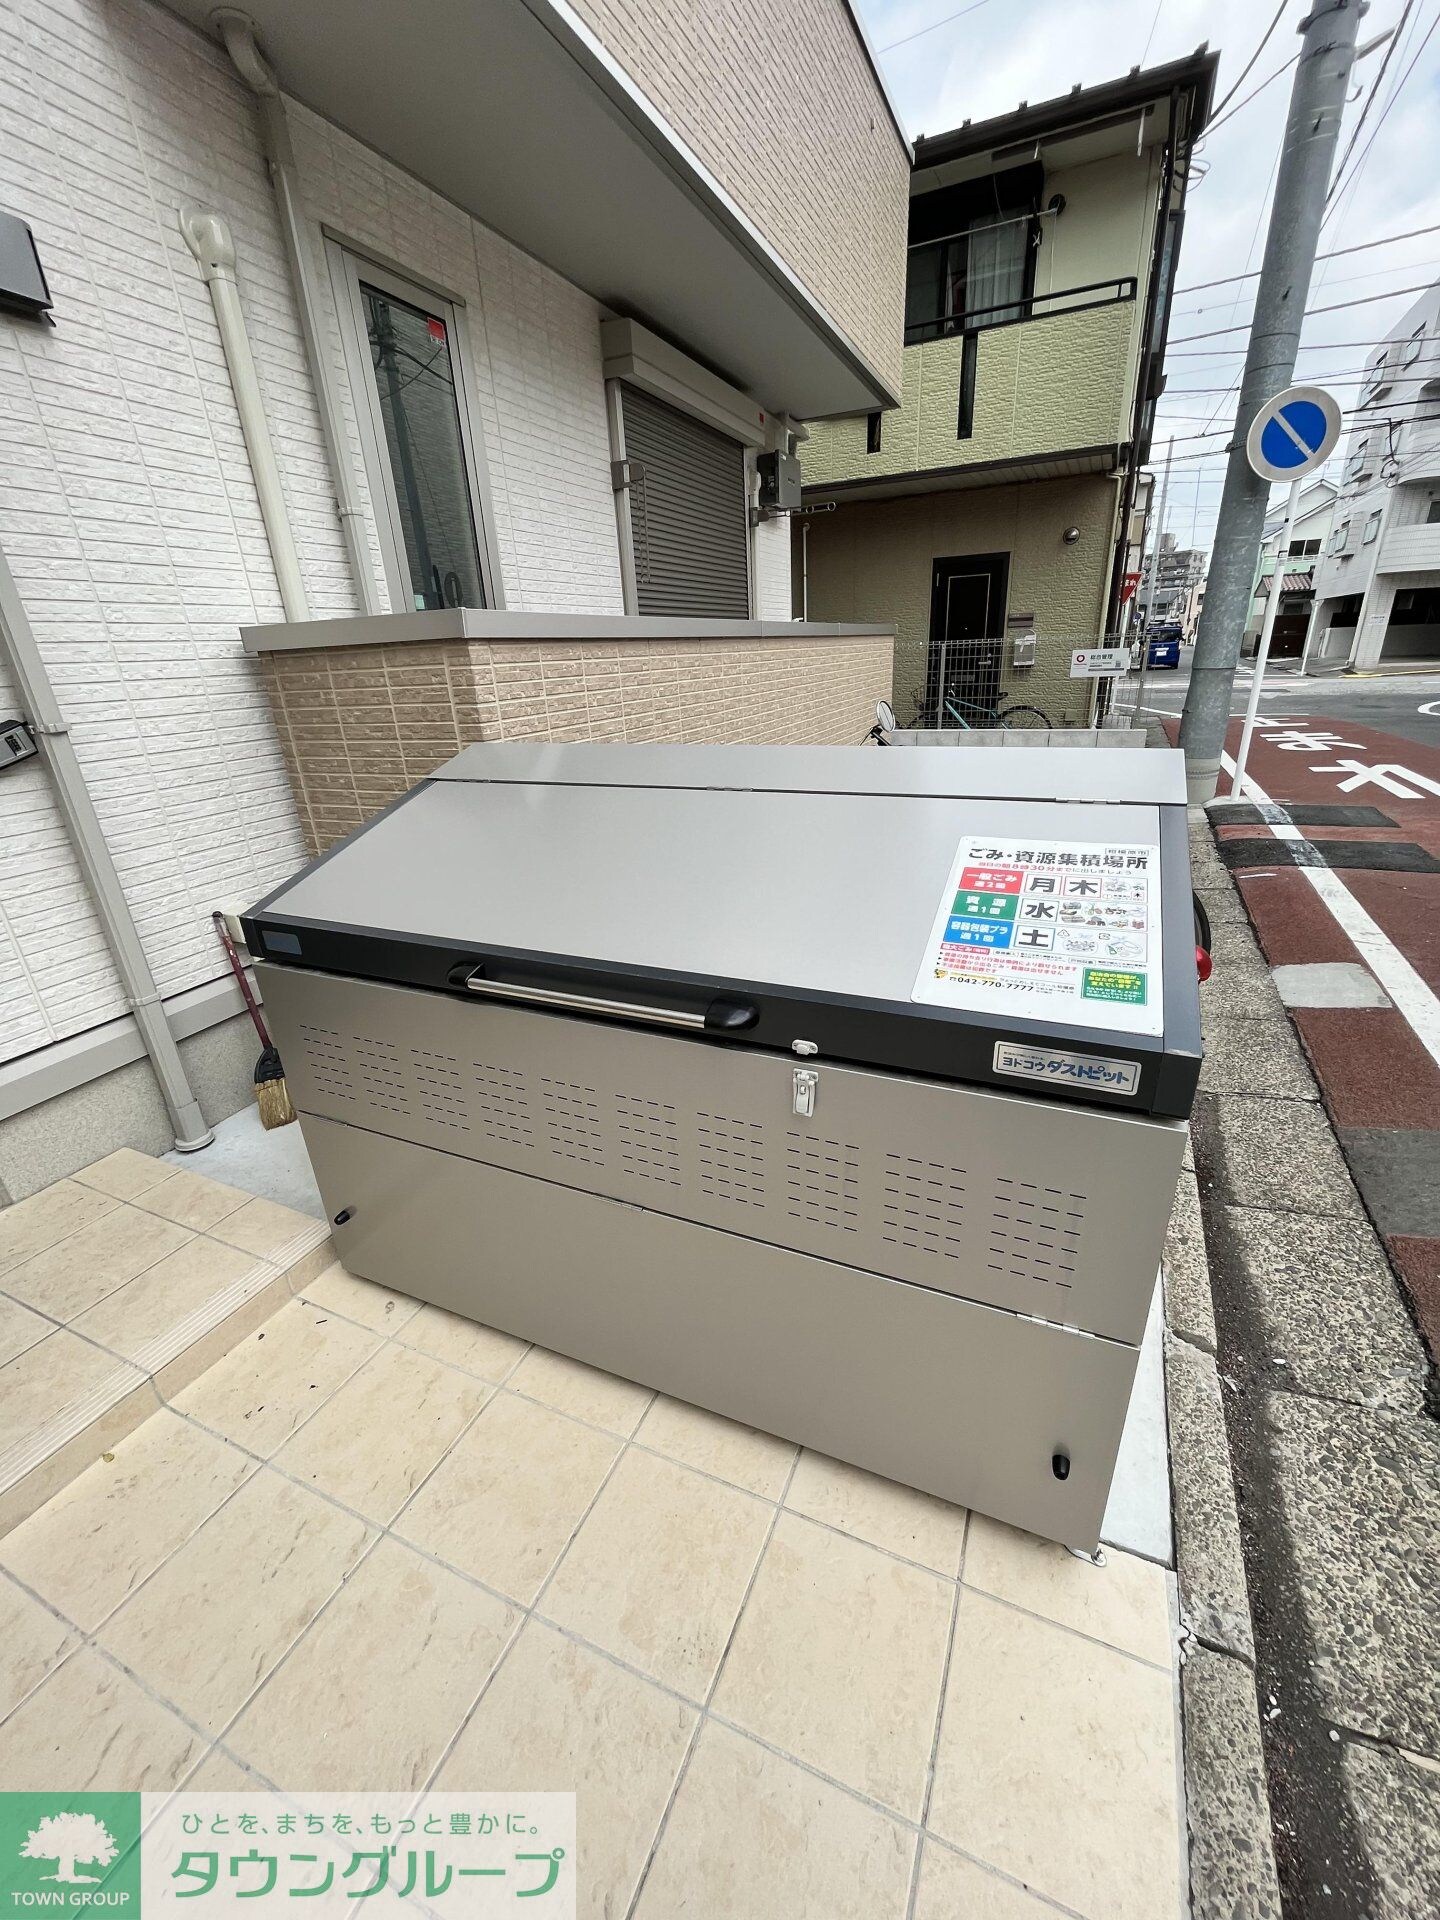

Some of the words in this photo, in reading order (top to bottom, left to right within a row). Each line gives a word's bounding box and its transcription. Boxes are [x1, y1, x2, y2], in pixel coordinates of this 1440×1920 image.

[969, 848, 1148, 869] ごみ・資源集積場所
[966, 872, 1018, 883] 一般ごみ
[1029, 877, 1056, 893] 月
[1068, 879, 1098, 895] 木
[1024, 902, 1055, 918] 水
[1018, 929, 1049, 947] 土
[957, 976, 1034, 991] 042-770-7777
